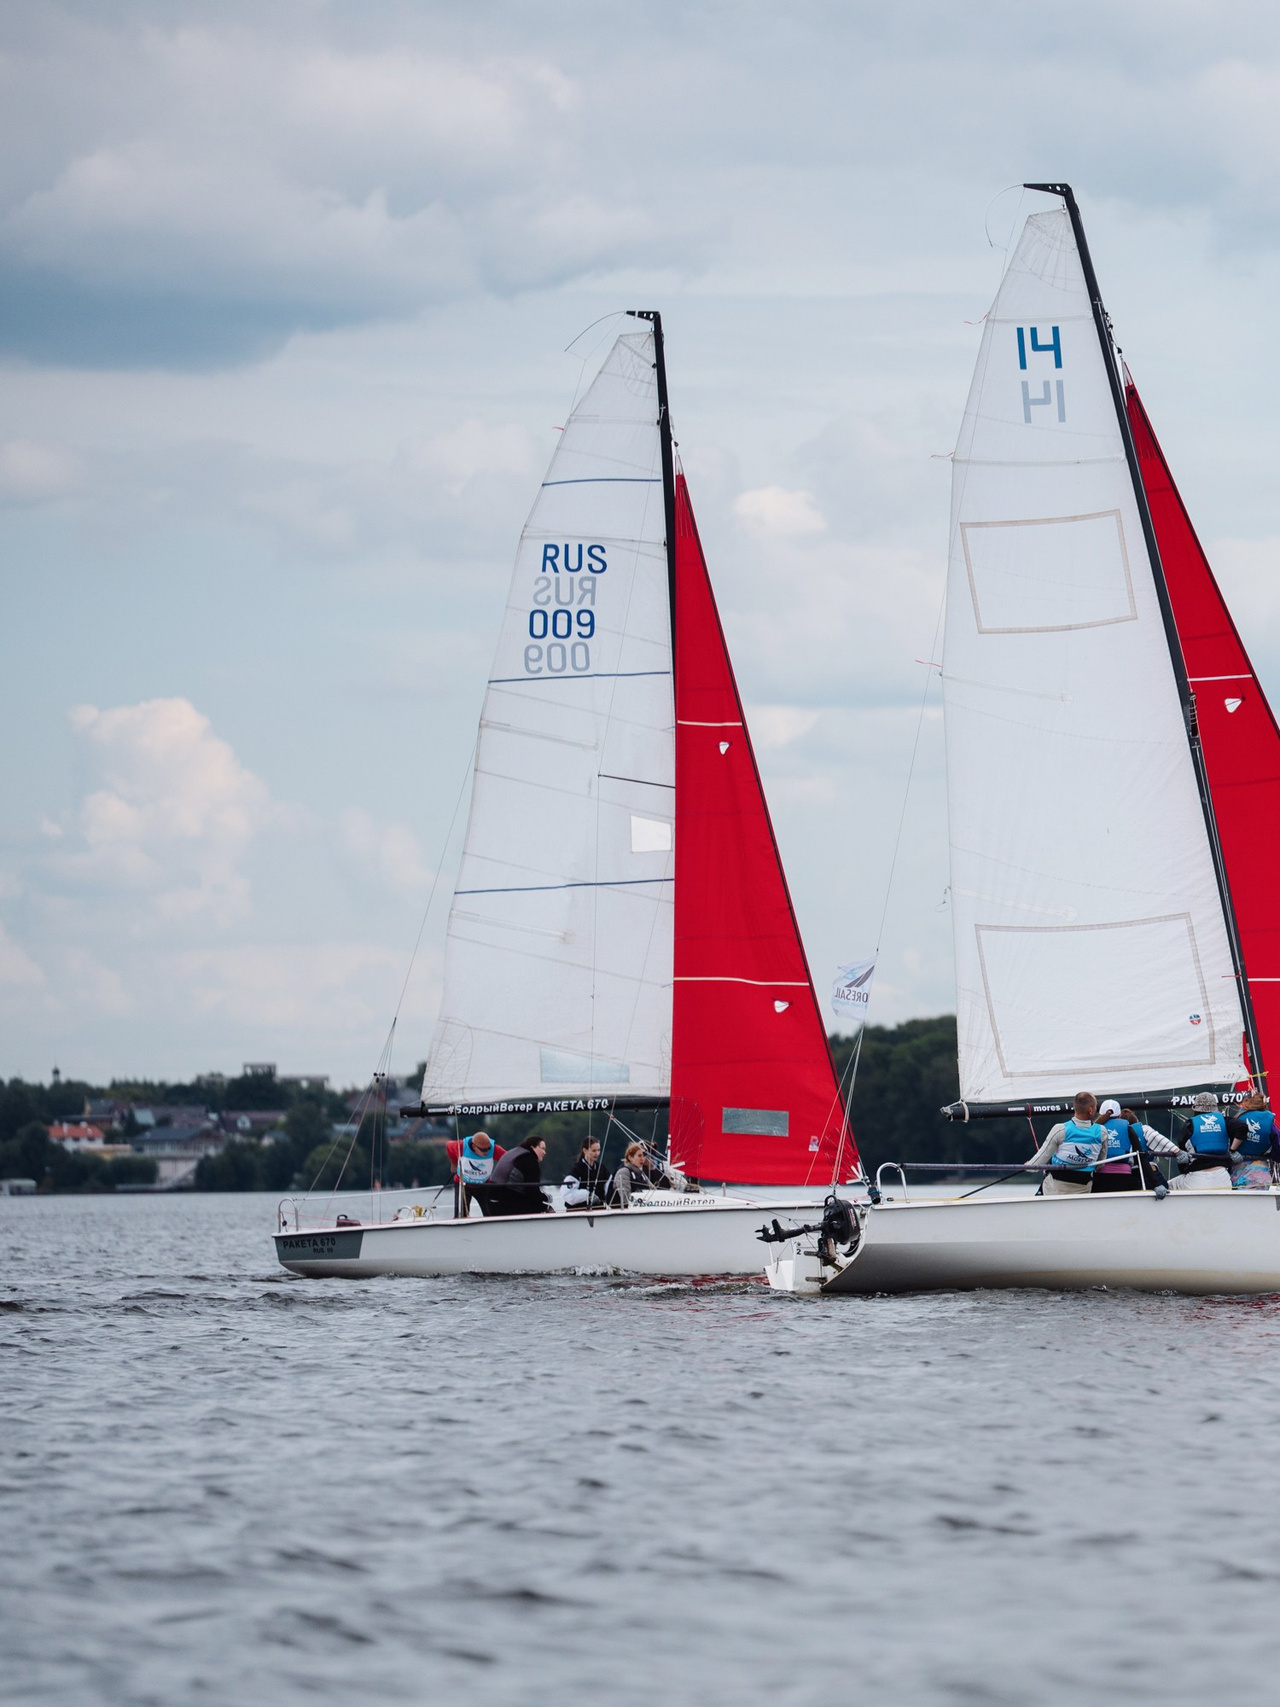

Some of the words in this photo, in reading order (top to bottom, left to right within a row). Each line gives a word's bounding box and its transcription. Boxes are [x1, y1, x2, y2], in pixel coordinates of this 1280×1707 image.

[1016, 326, 1062, 370] 14
[541, 543, 608, 574] RUS
[529, 609, 595, 639] 009
[537, 1100, 584, 1112] РАКЕТА
[587, 1098, 608, 1110] 670
[1222, 1092, 1243, 1104] 670
[320, 1237, 336, 1247] 670
